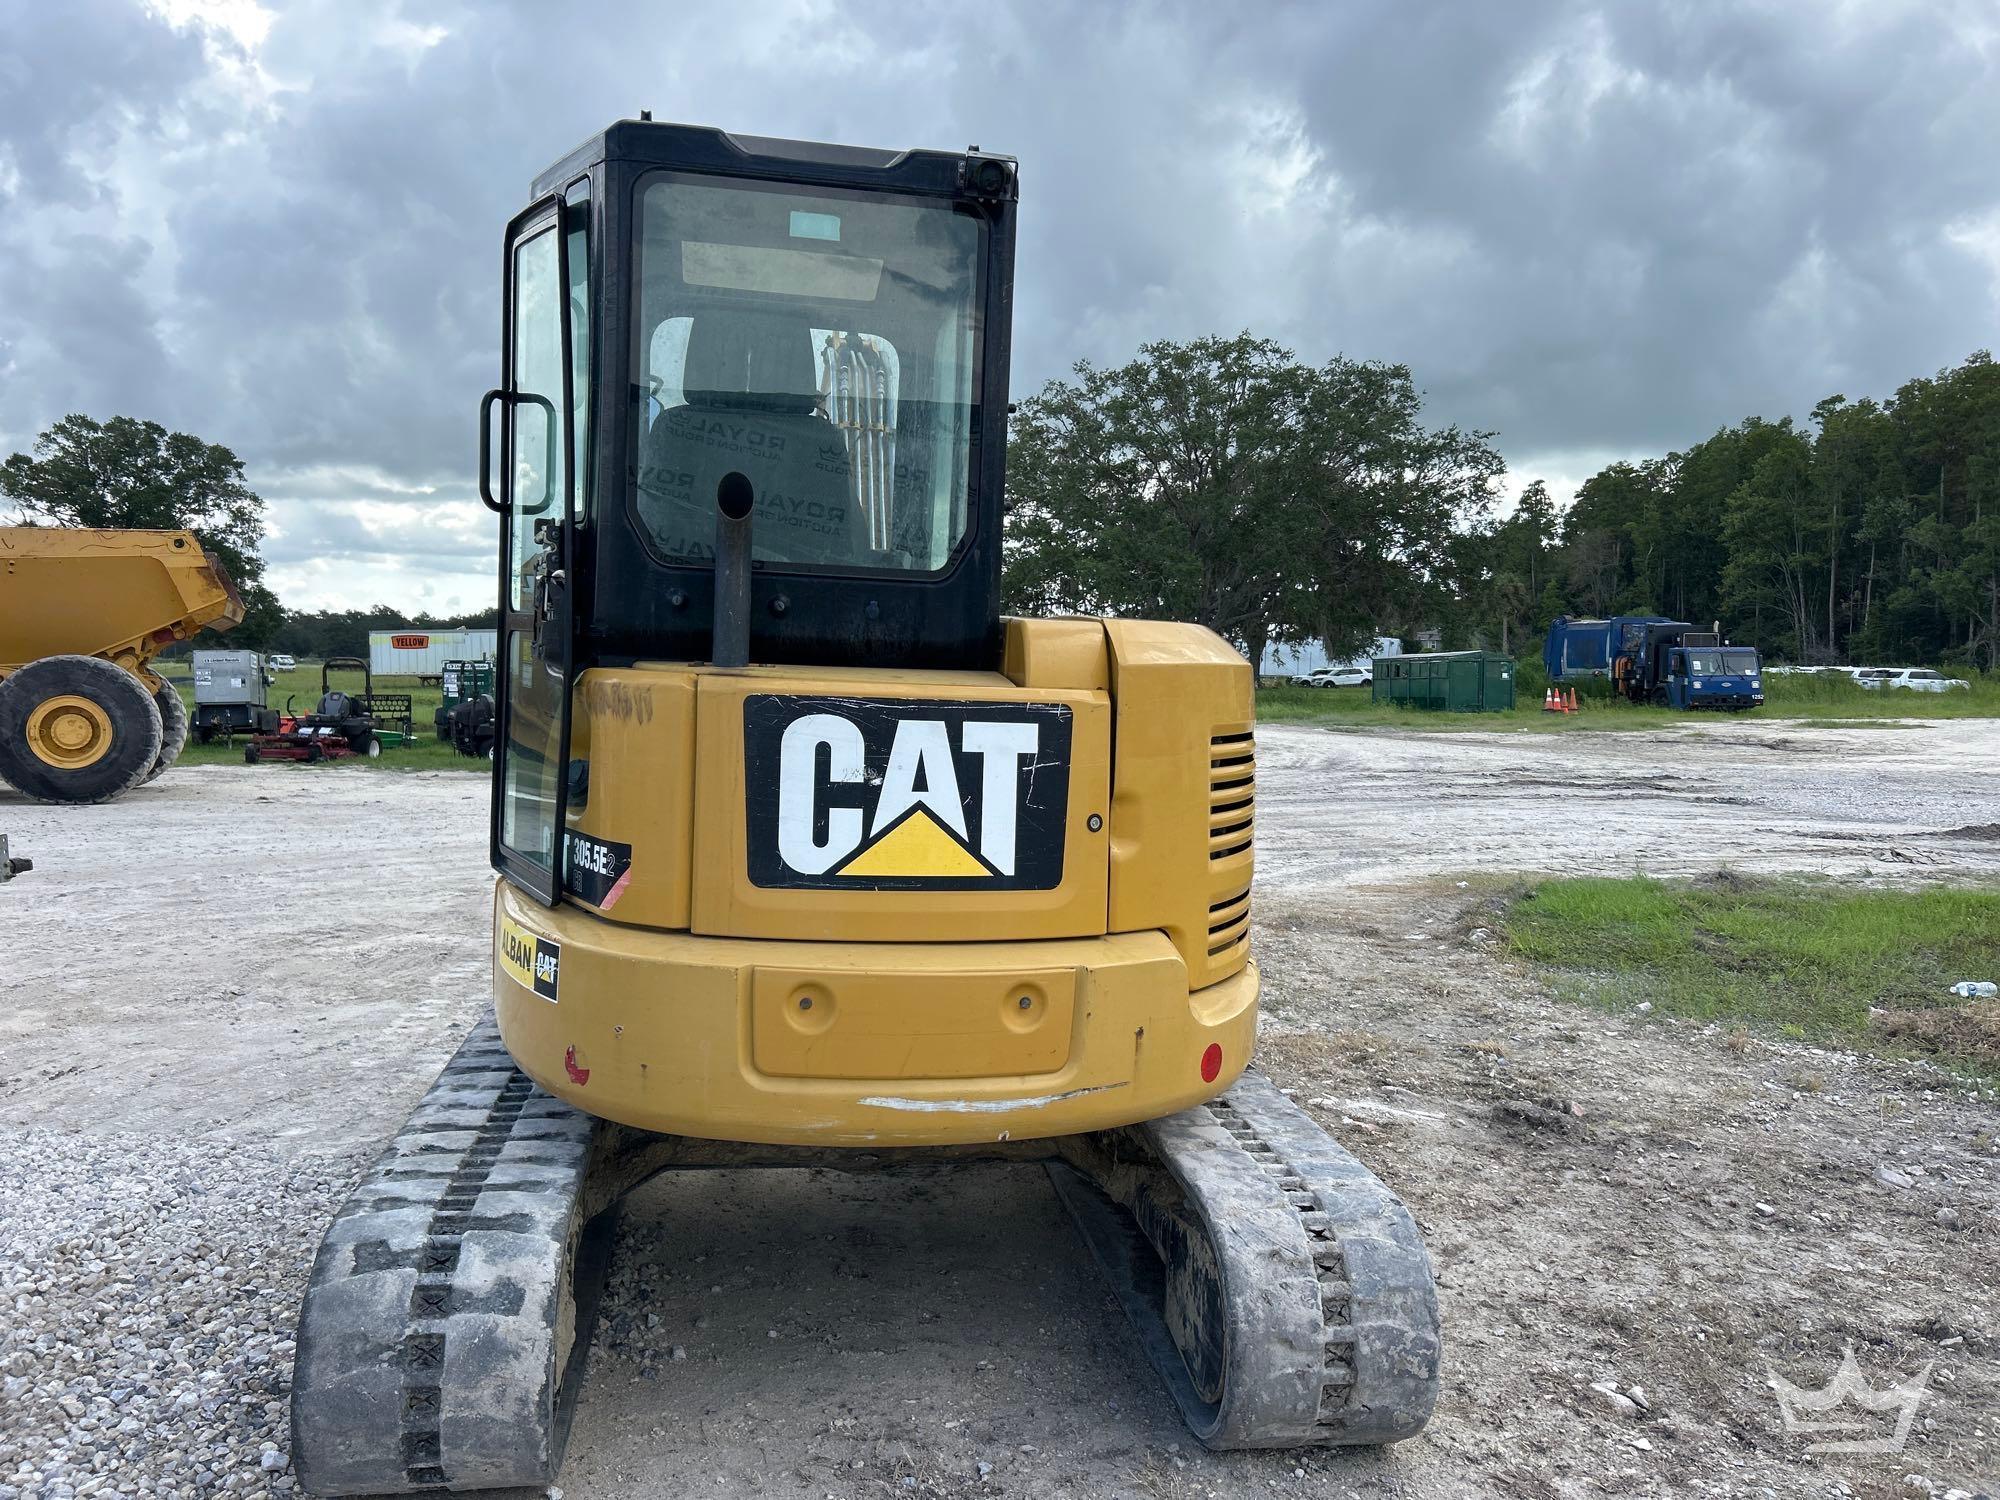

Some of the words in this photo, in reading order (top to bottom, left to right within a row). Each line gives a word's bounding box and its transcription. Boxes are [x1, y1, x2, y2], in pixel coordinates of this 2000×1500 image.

[396, 637, 424, 647] YELLOW
[778, 713, 1039, 876] CAT
[501, 928, 532, 972] ALBAN
[536, 951, 558, 984] CAT
